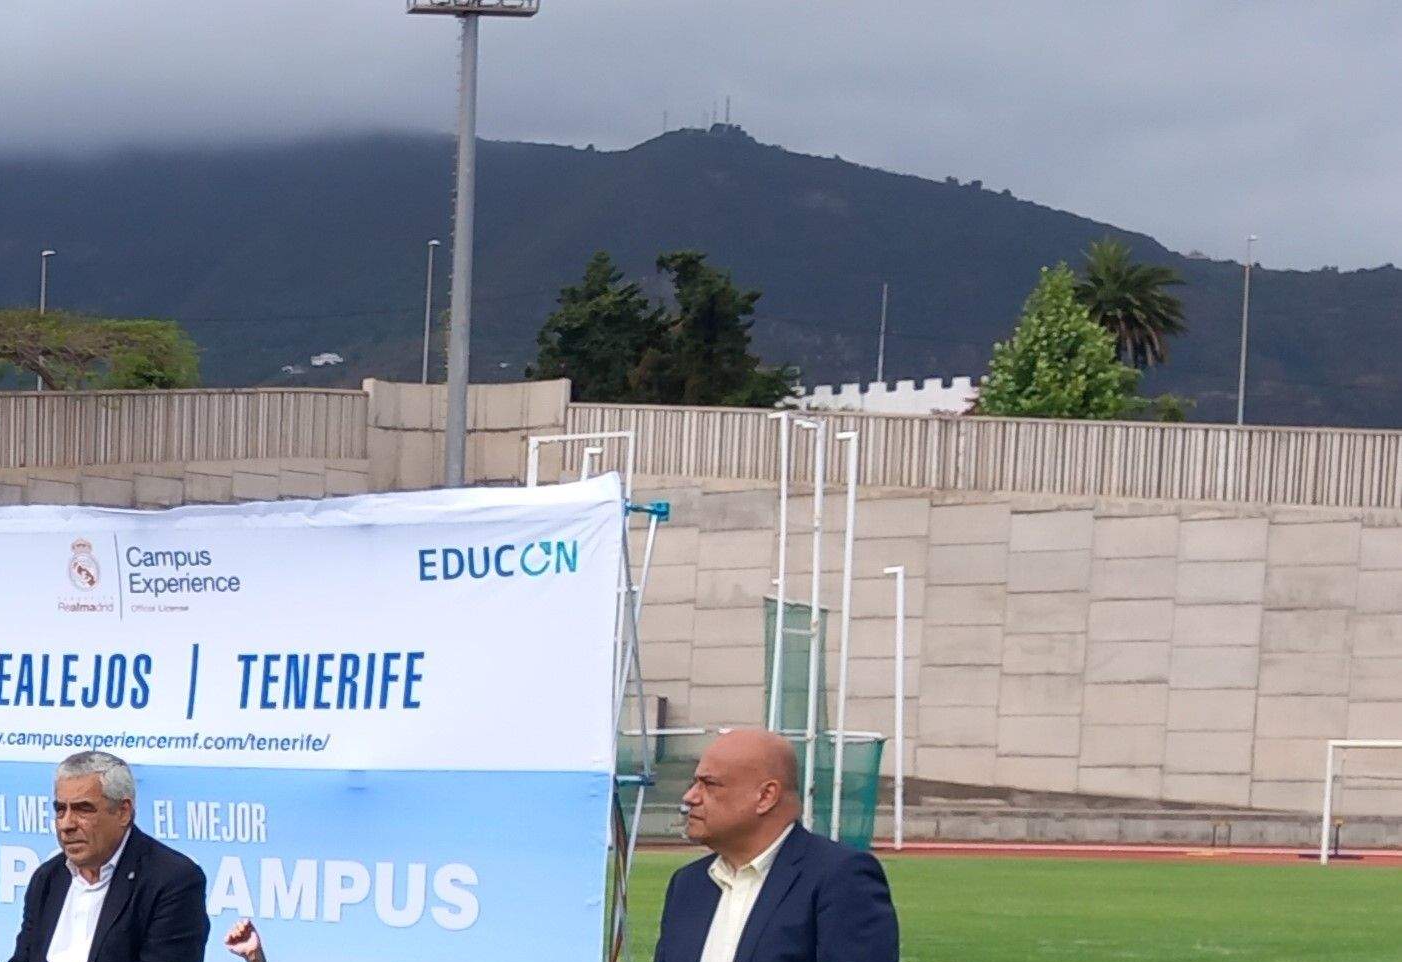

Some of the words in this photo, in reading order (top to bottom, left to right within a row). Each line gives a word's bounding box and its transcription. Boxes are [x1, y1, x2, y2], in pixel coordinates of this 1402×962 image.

[126, 546, 212, 571] Campus
[419, 540, 577, 581] EDUCON
[129, 571, 240, 597] Experience
[237, 651, 425, 710] TENERIFE
[153, 799, 180, 839] EL
[186, 801, 267, 843] MEJOR
[207, 855, 480, 931] AMPUS
